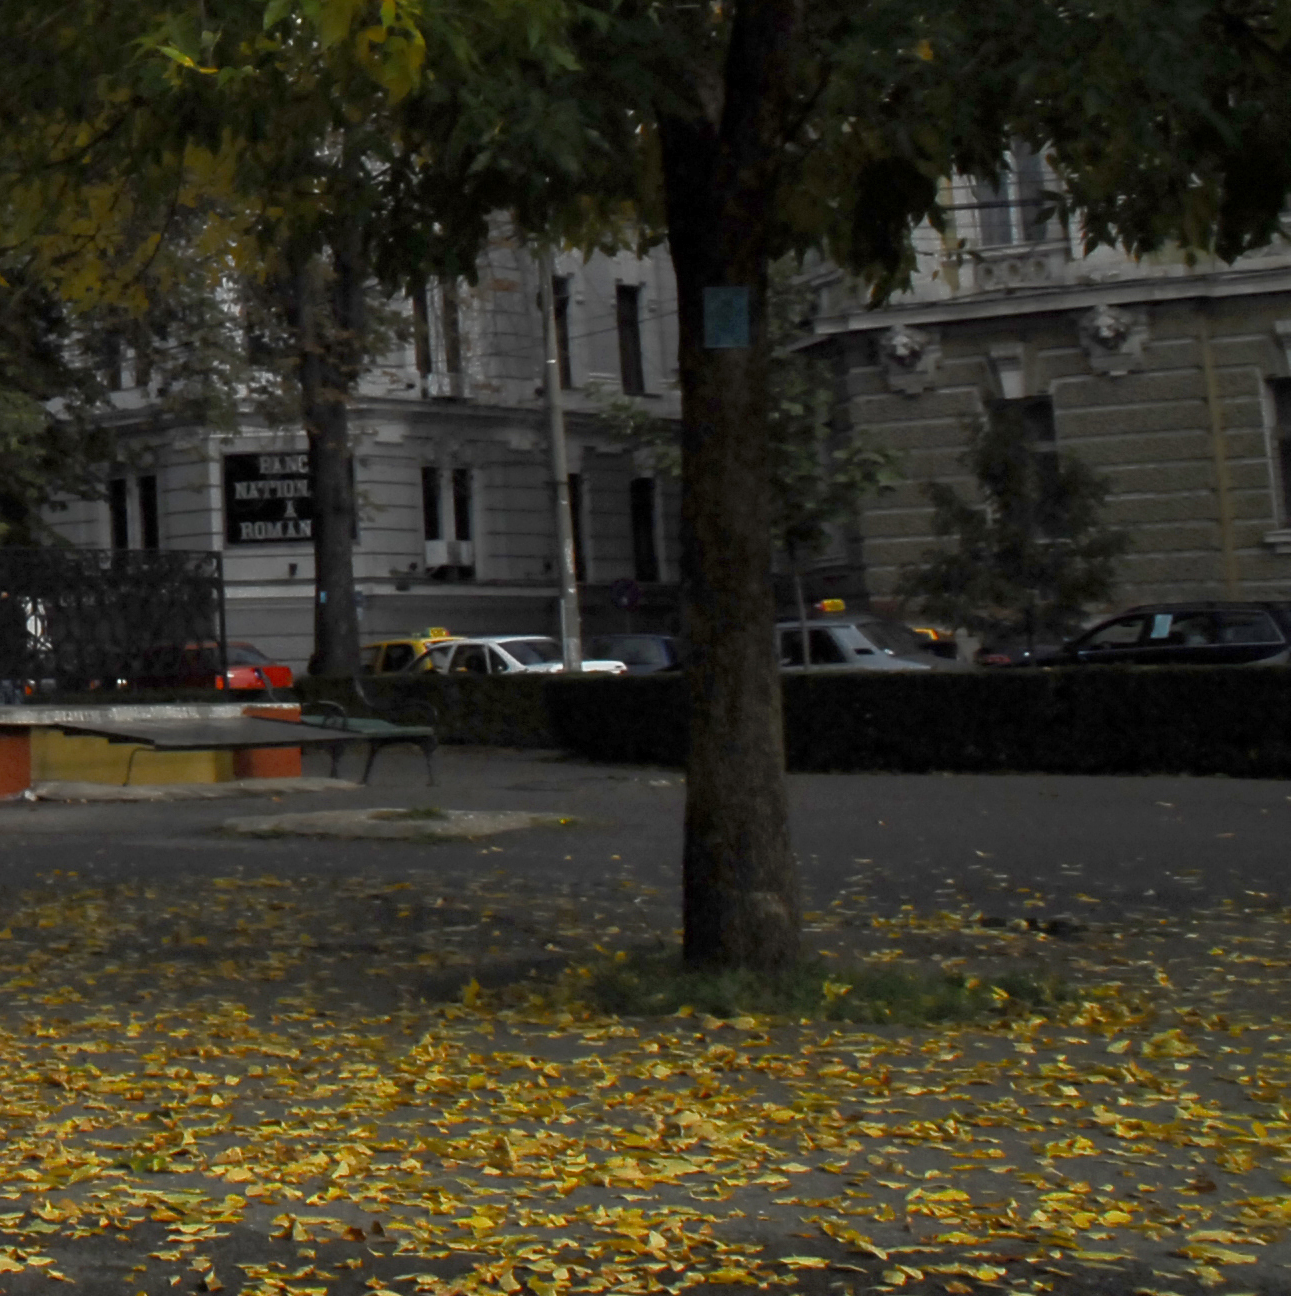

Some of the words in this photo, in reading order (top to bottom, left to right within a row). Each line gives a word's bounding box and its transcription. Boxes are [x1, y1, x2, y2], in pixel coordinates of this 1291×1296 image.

[259, 454, 309, 474] BANC
[234, 479, 311, 499] NATION
[283, 500, 297, 517] A
[239, 518, 312, 540] ROMAN
